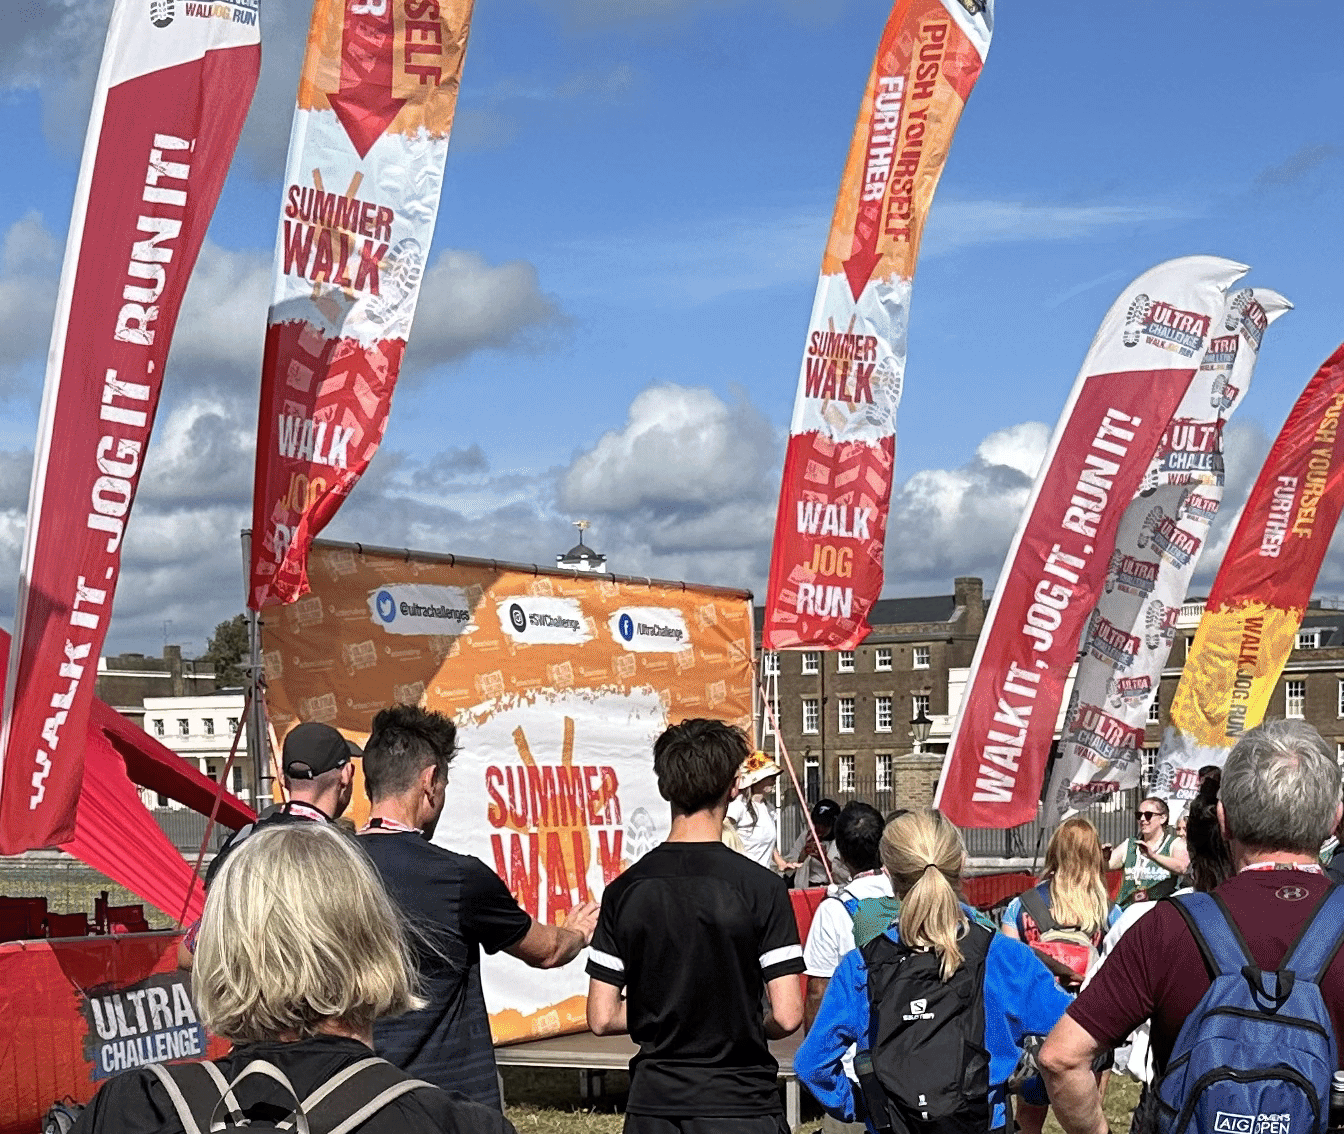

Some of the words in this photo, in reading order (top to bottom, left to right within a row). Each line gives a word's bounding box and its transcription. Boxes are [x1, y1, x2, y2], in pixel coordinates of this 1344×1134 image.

[911, 23, 948, 100] PUSH
[862, 75, 905, 201] FURTHER
[143, 133, 196, 206] IT!
[884, 109, 929, 243] YOURSELF
[285, 184, 394, 242] SUMMER
[114, 215, 183, 345] RUN
[283, 220, 389, 297] WALK
[808, 330, 878, 362] SUMMER
[1153, 306, 1203, 337] ULTRA
[804, 357, 876, 404] WALK
[278, 414, 352, 469] WALK
[87, 435, 142, 553] JOG
[1259, 474, 1298, 559] FURTHER
[1292, 443, 1334, 540] YOURSELF
[273, 523, 299, 565] R
[796, 501, 871, 540] WALK
[1161, 521, 1195, 555] ULTRA
[803, 545, 853, 578] JOG
[1122, 559, 1155, 582] ULTRA
[796, 584, 853, 618] RUN
[972, 697, 1033, 803] WALK
[1022, 580, 1073, 652] JOG
[1062, 454, 1120, 538] RUN
[1092, 407, 1142, 459] IT!
[1098, 622, 1135, 655] ULTRA
[29, 639, 91, 809] WALK
[1082, 710, 1137, 749] ULTRA
[485, 765, 622, 828] SUMMER
[90, 983, 196, 1040] ULTRA
[101, 1028, 201, 1073] CHALLENGE
[1219, 1117, 1250, 1131] AIG
